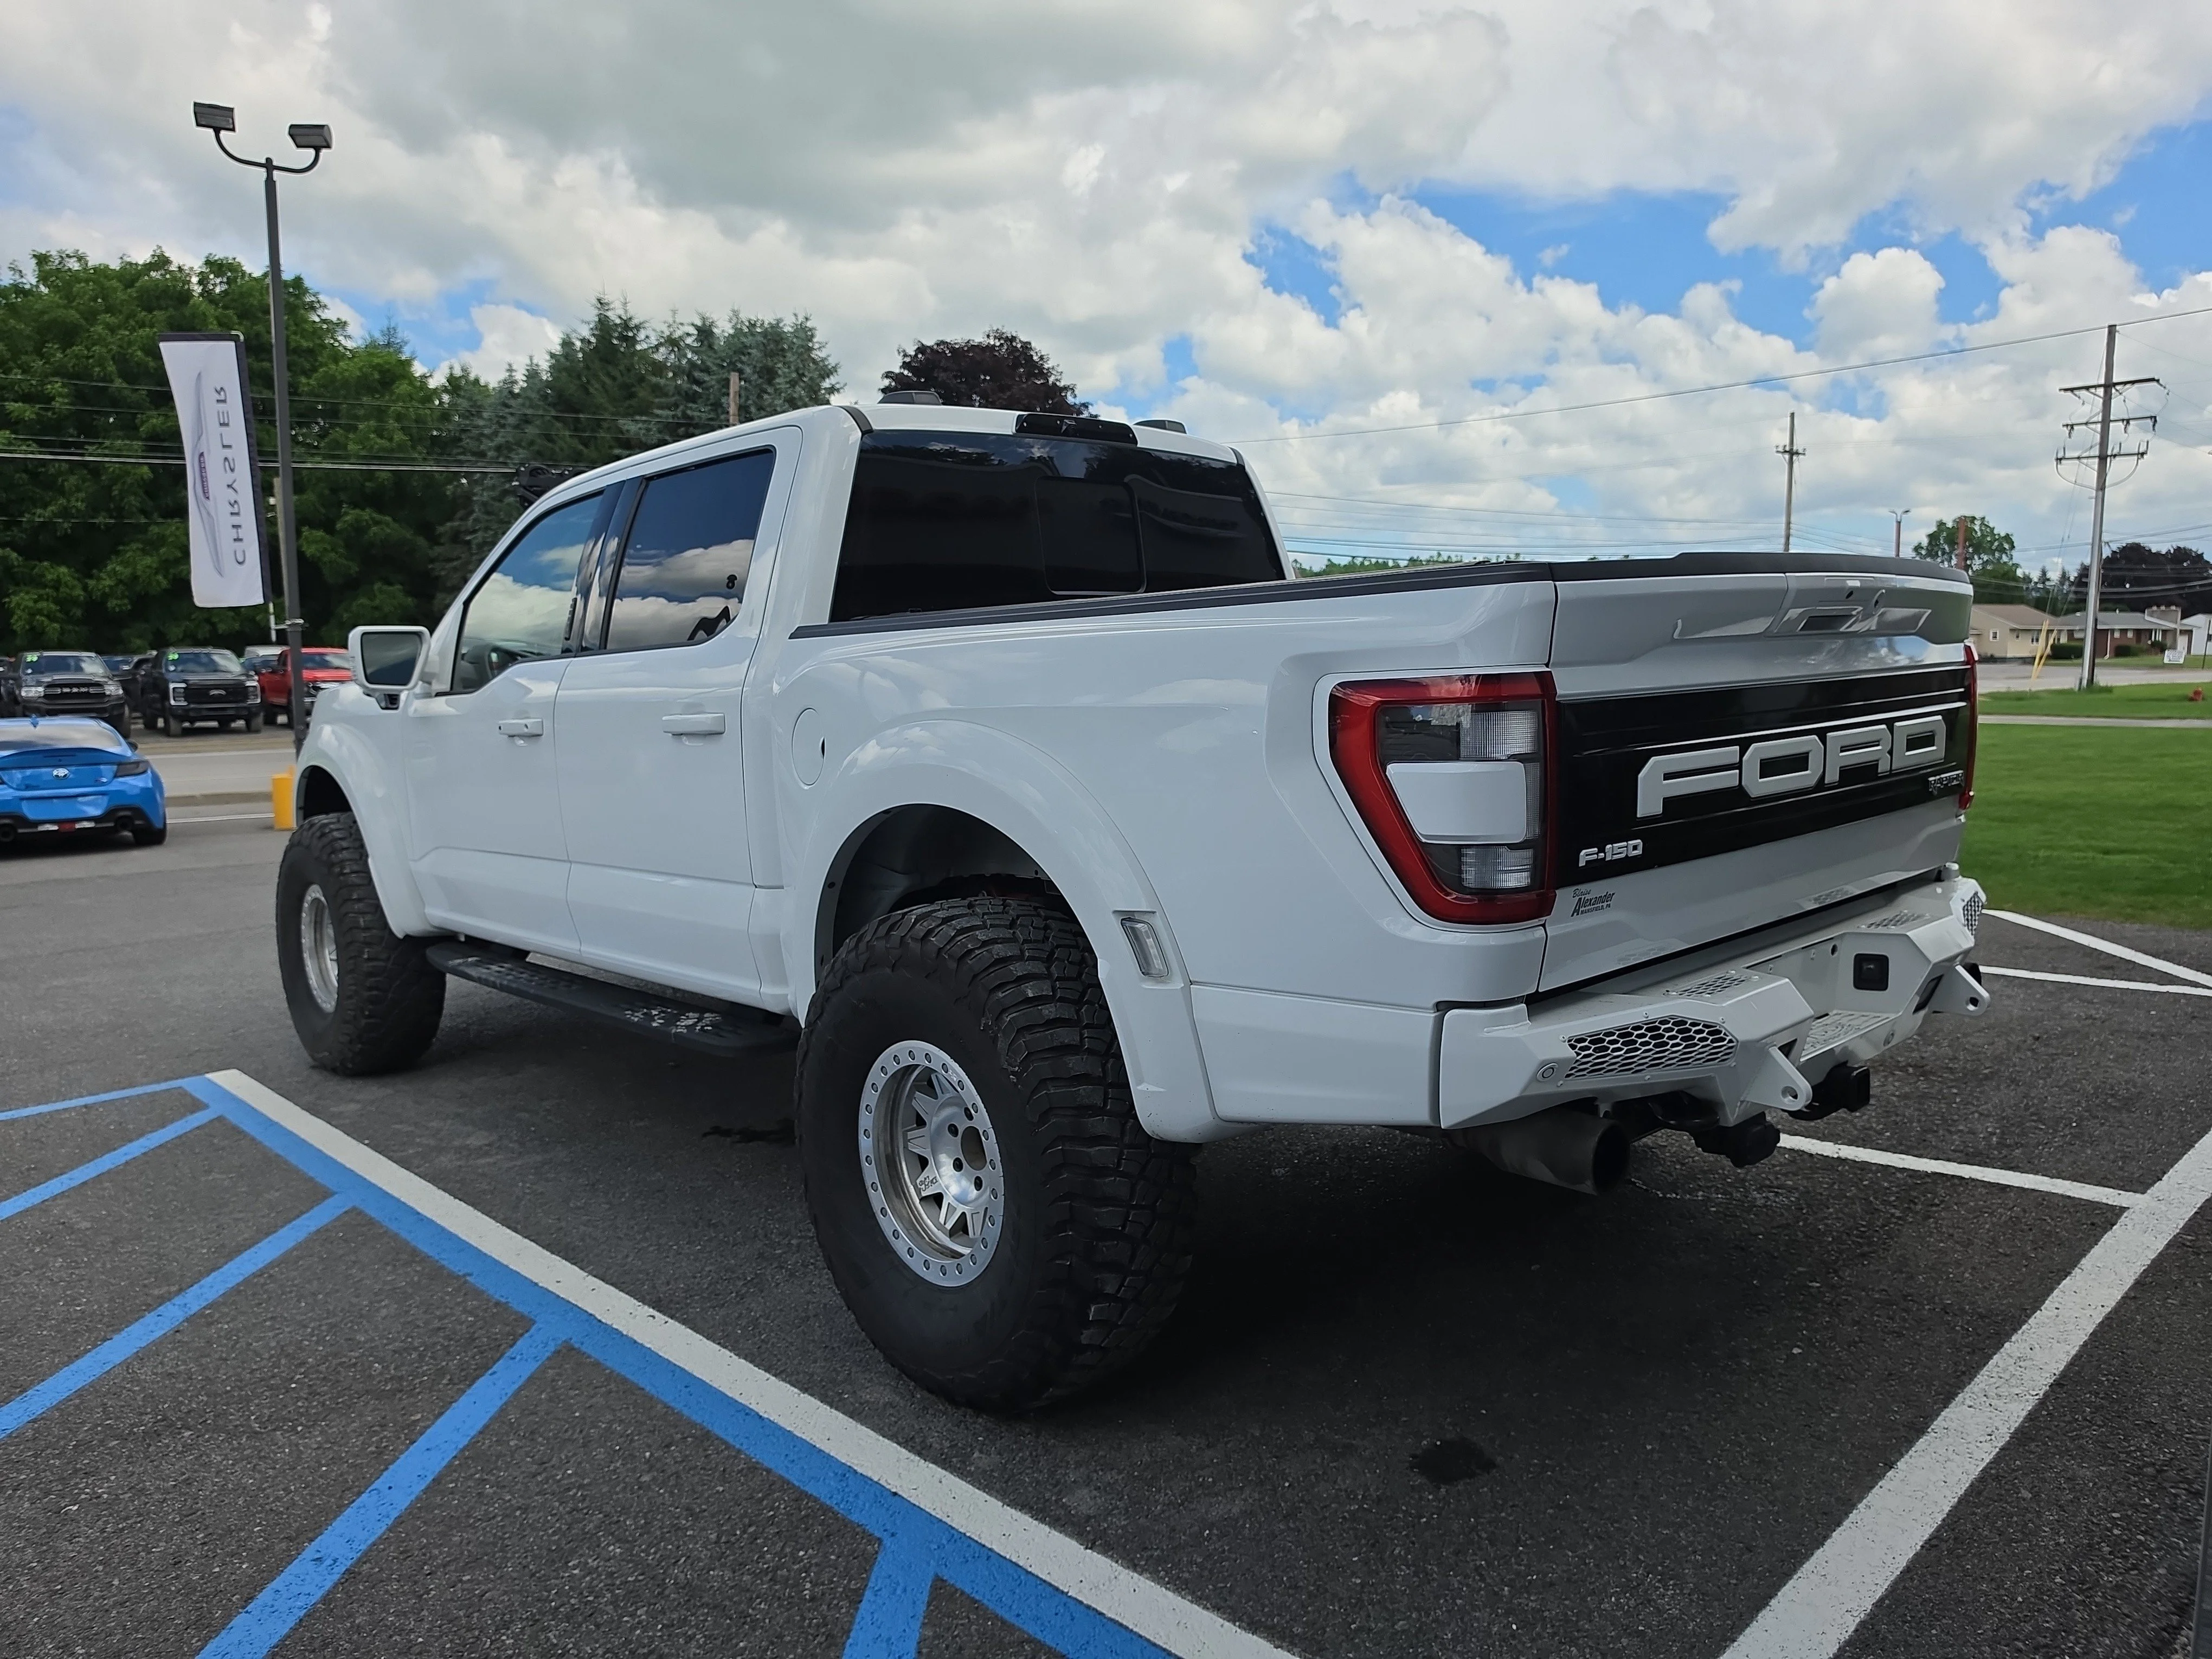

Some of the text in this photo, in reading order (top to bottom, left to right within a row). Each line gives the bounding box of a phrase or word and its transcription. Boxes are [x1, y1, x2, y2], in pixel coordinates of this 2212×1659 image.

[1636, 715, 1947, 819] FORD
[1578, 839, 1643, 867] F-150
[1571, 891, 1615, 917] Alexander
[1572, 888, 1592, 898] Blaise
